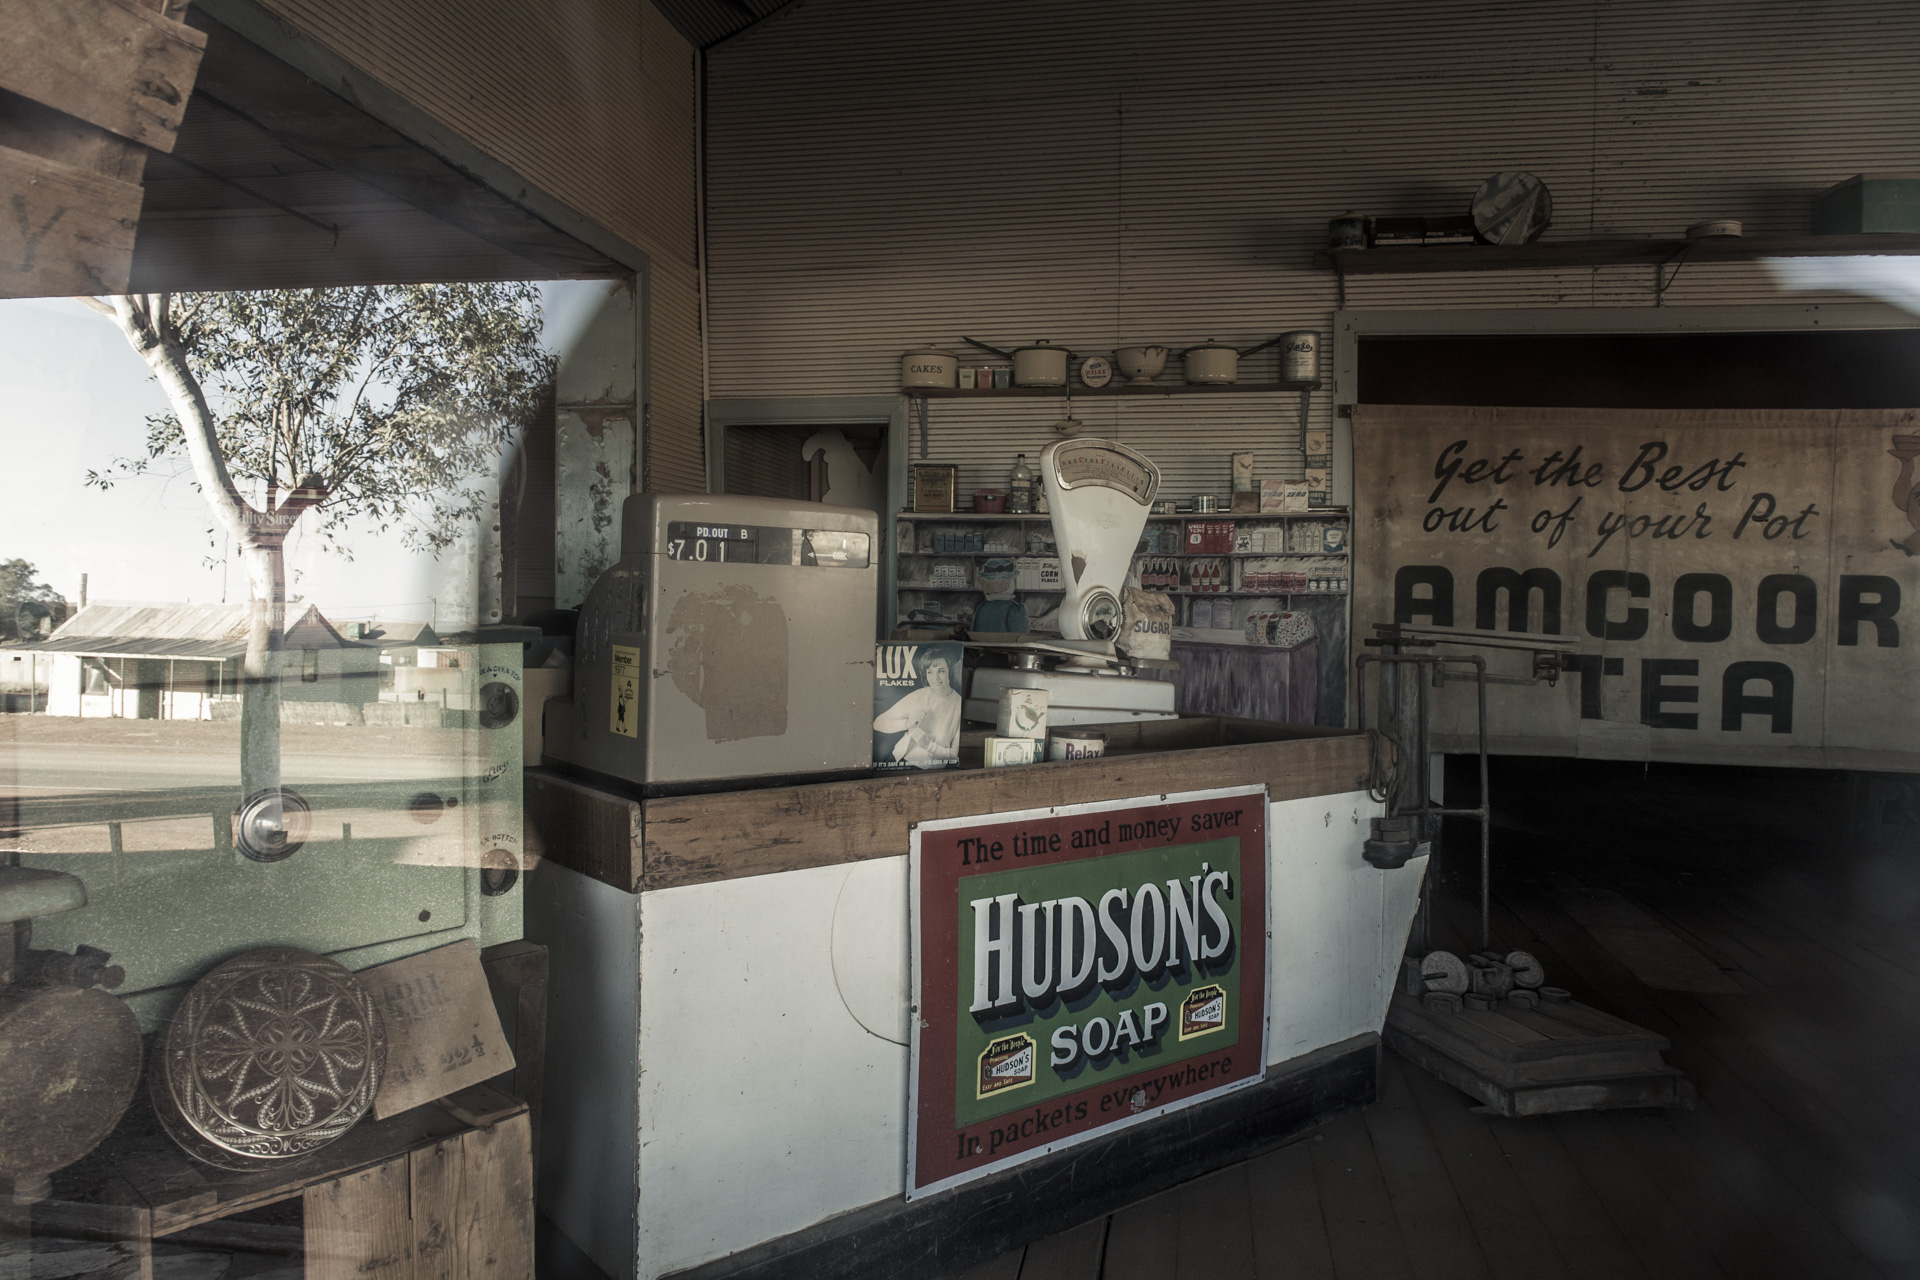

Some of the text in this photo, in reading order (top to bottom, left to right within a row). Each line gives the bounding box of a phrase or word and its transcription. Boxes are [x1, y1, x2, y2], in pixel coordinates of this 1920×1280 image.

[911, 365, 943, 374] CAKES
[1428, 440, 1746, 502] Get the Best
[697, 527, 748, 539] PD.OUT B
[1422, 492, 1818, 558] out of your Pot
[1394, 565, 1901, 647] AMCOOR
[1134, 620, 1170, 635] SUGAR
[615, 654, 632, 664] Member
[876, 645, 918, 679] LUX
[1561, 653, 1795, 734] TEA
[1065, 743, 1100, 761] Relax
[958, 807, 1243, 866] The time and money saver
[968, 862, 1230, 1013] HUDSON'S
[1194, 1000, 1221, 1020] HUDSON'S
[1010, 1037, 1025, 1050] People
[1050, 1002, 1168, 1067] SOAP
[996, 1051, 1030, 1075] HUDSON'S
[1014, 1065, 1028, 1075] SOAP
[957, 1055, 1232, 1160] In packets everywhere
